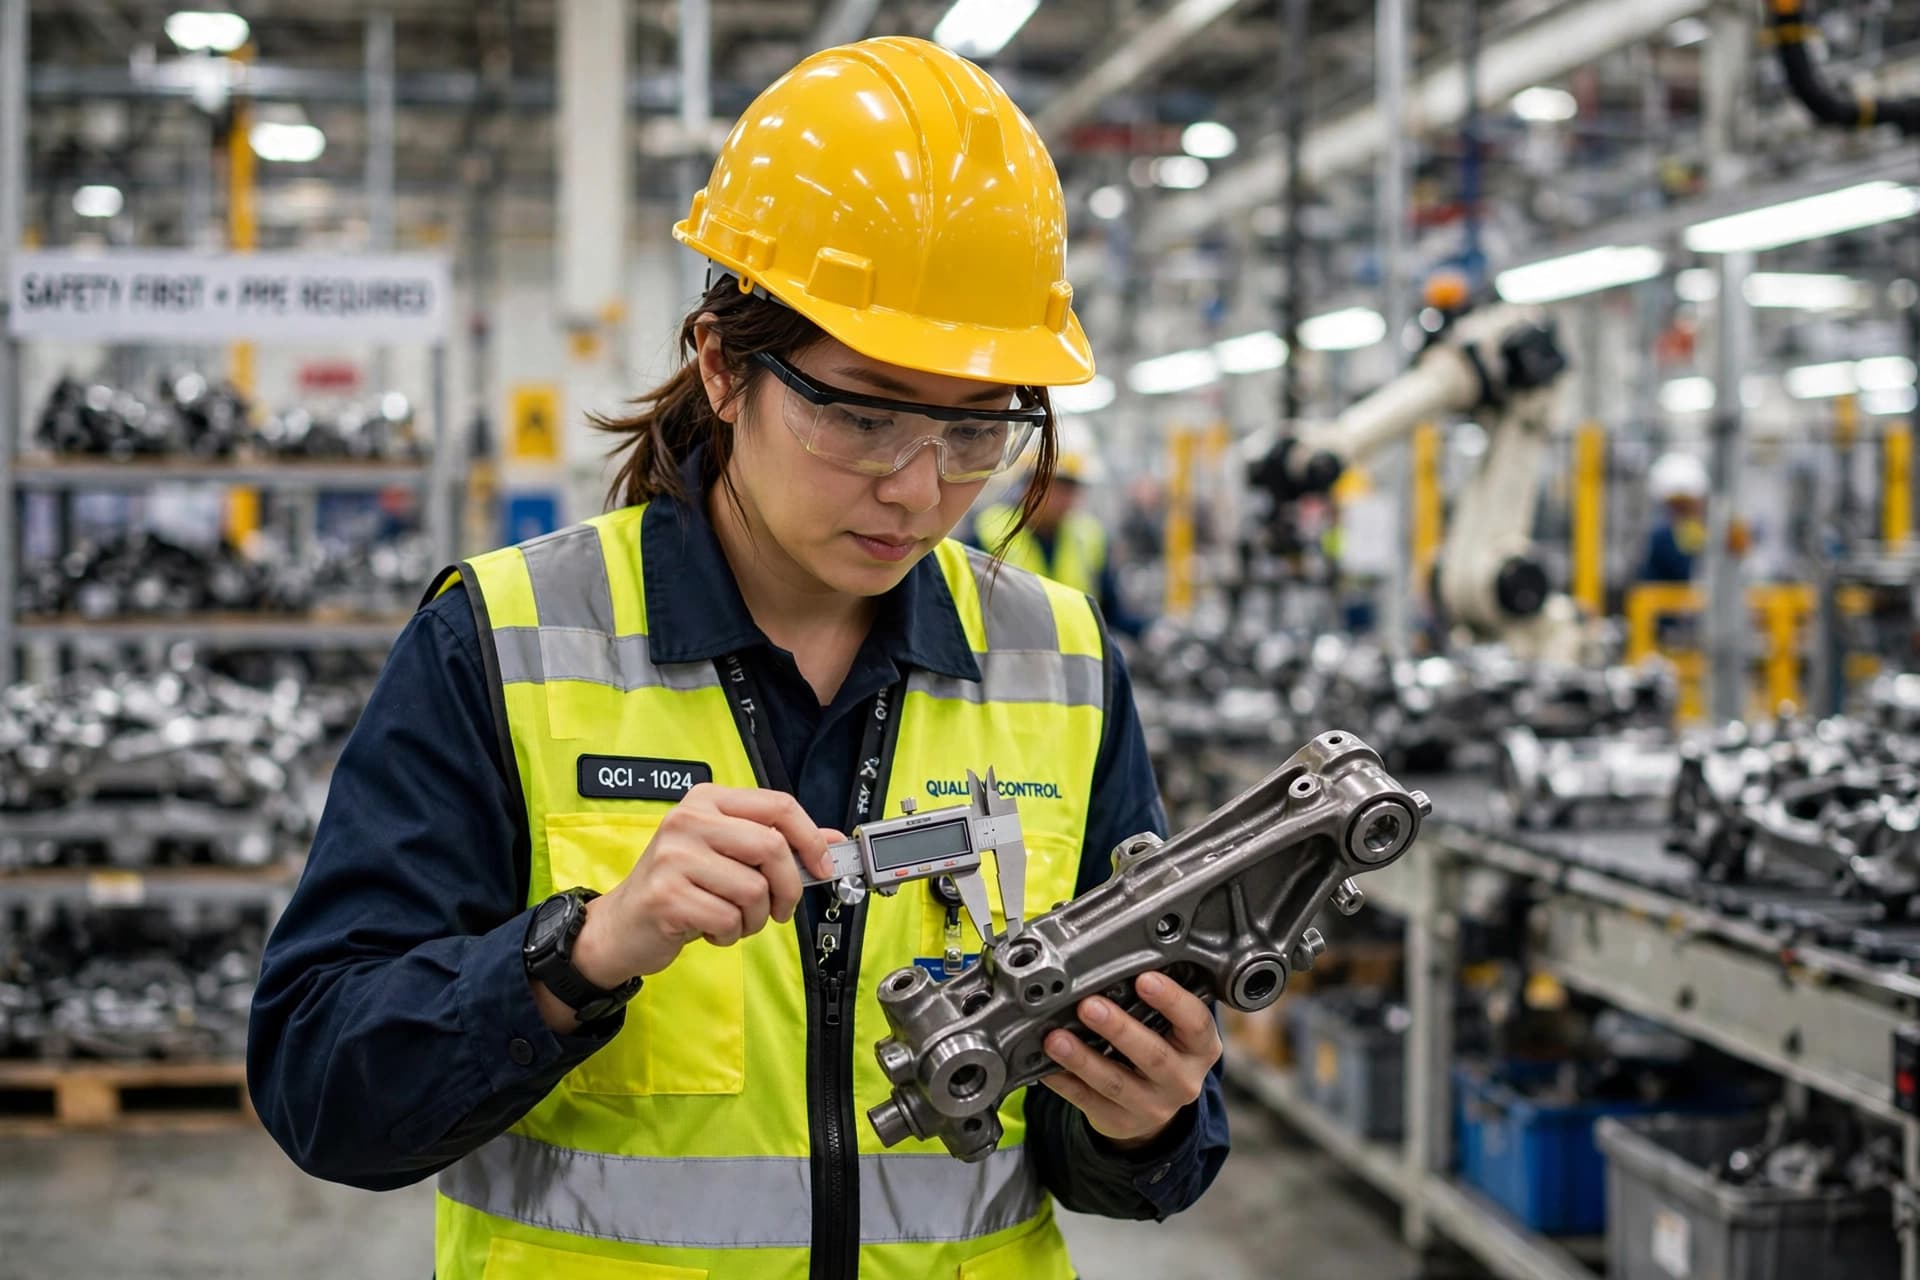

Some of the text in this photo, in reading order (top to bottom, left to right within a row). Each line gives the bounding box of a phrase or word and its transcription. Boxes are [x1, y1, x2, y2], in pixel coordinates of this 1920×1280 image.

[23, 274, 121, 311] SAFETY
[131, 275, 204, 312] FIRST
[301, 277, 433, 317] REQUIRED
[598, 767, 632, 788] QCI
[650, 770, 693, 790] 1024
[926, 780, 1062, 798] QUALIY CONTROL
